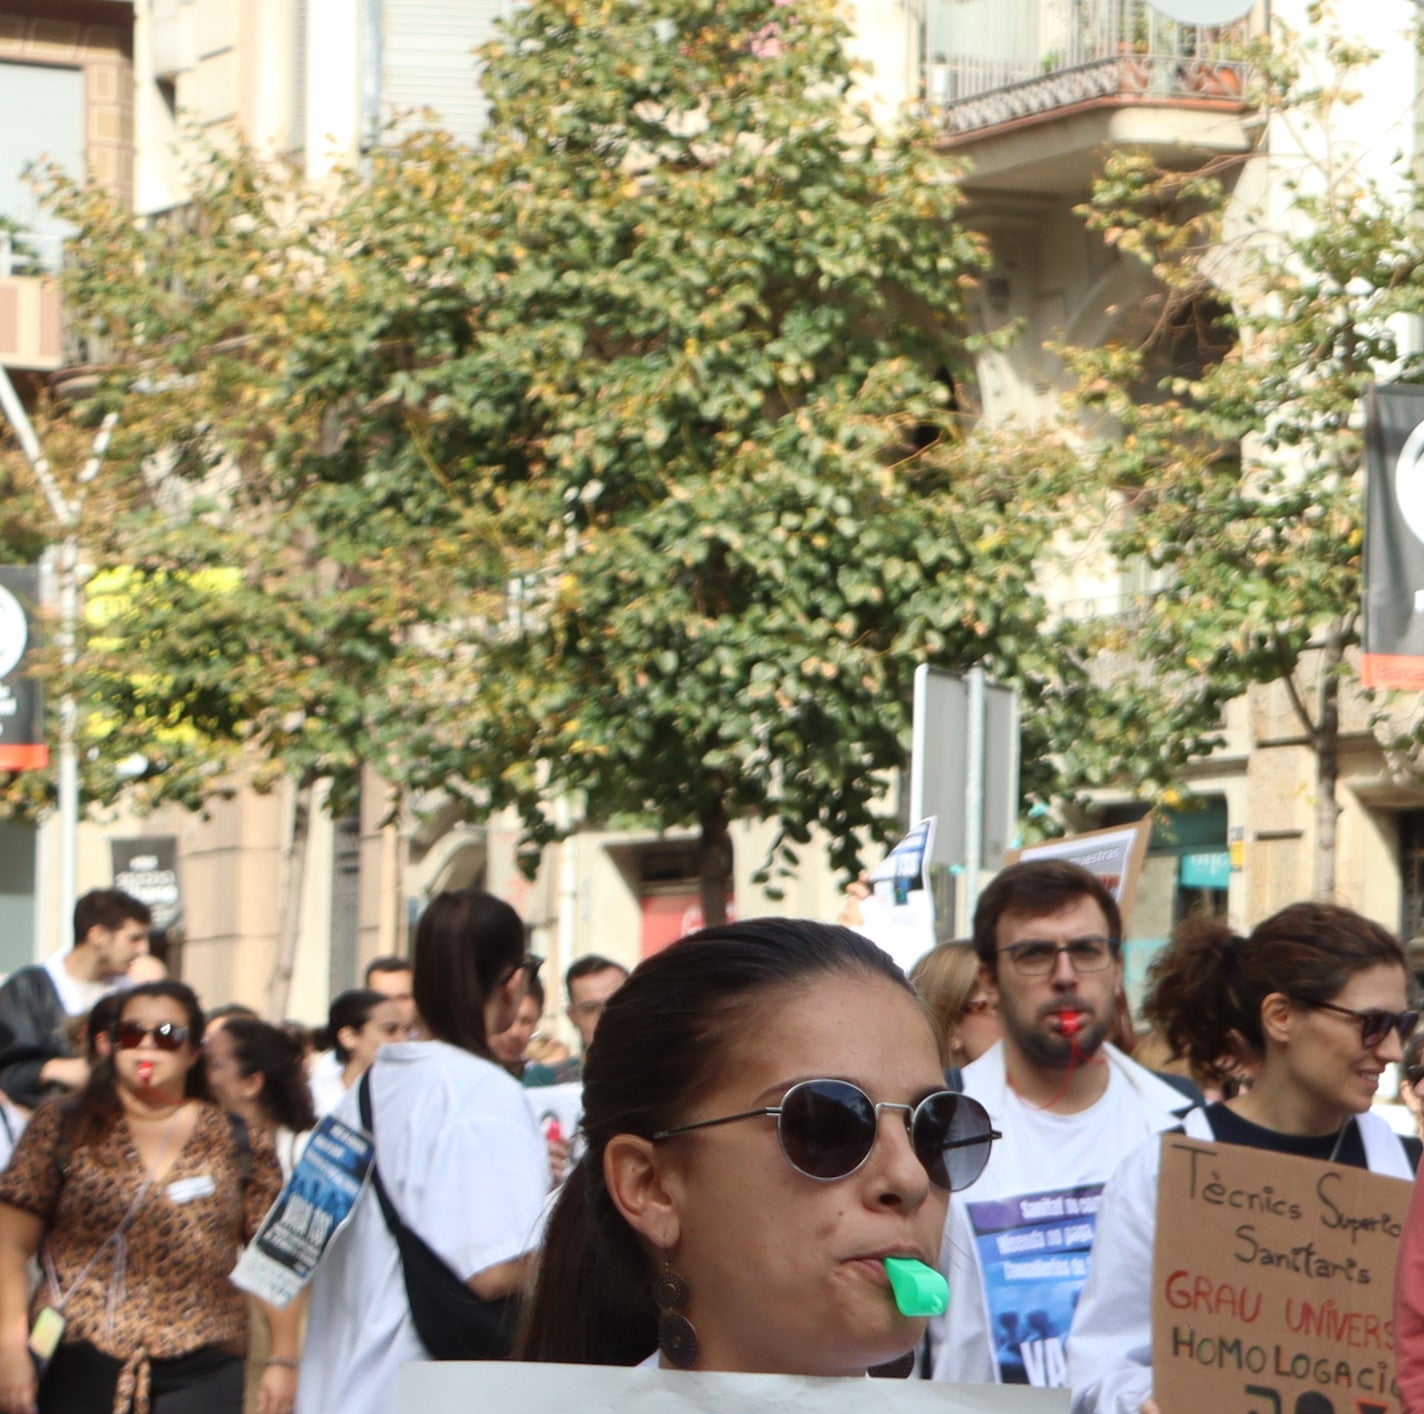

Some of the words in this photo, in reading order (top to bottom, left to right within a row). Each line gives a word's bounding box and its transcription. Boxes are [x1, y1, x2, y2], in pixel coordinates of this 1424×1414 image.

[1172, 1144, 1301, 1219] Tècnics
[1317, 1172, 1402, 1244] Superio
[1235, 1225, 1371, 1284] Sanitaris
[1165, 1270, 1262, 1322] GRAU
[1285, 1300, 1394, 1351] UNIVERS
